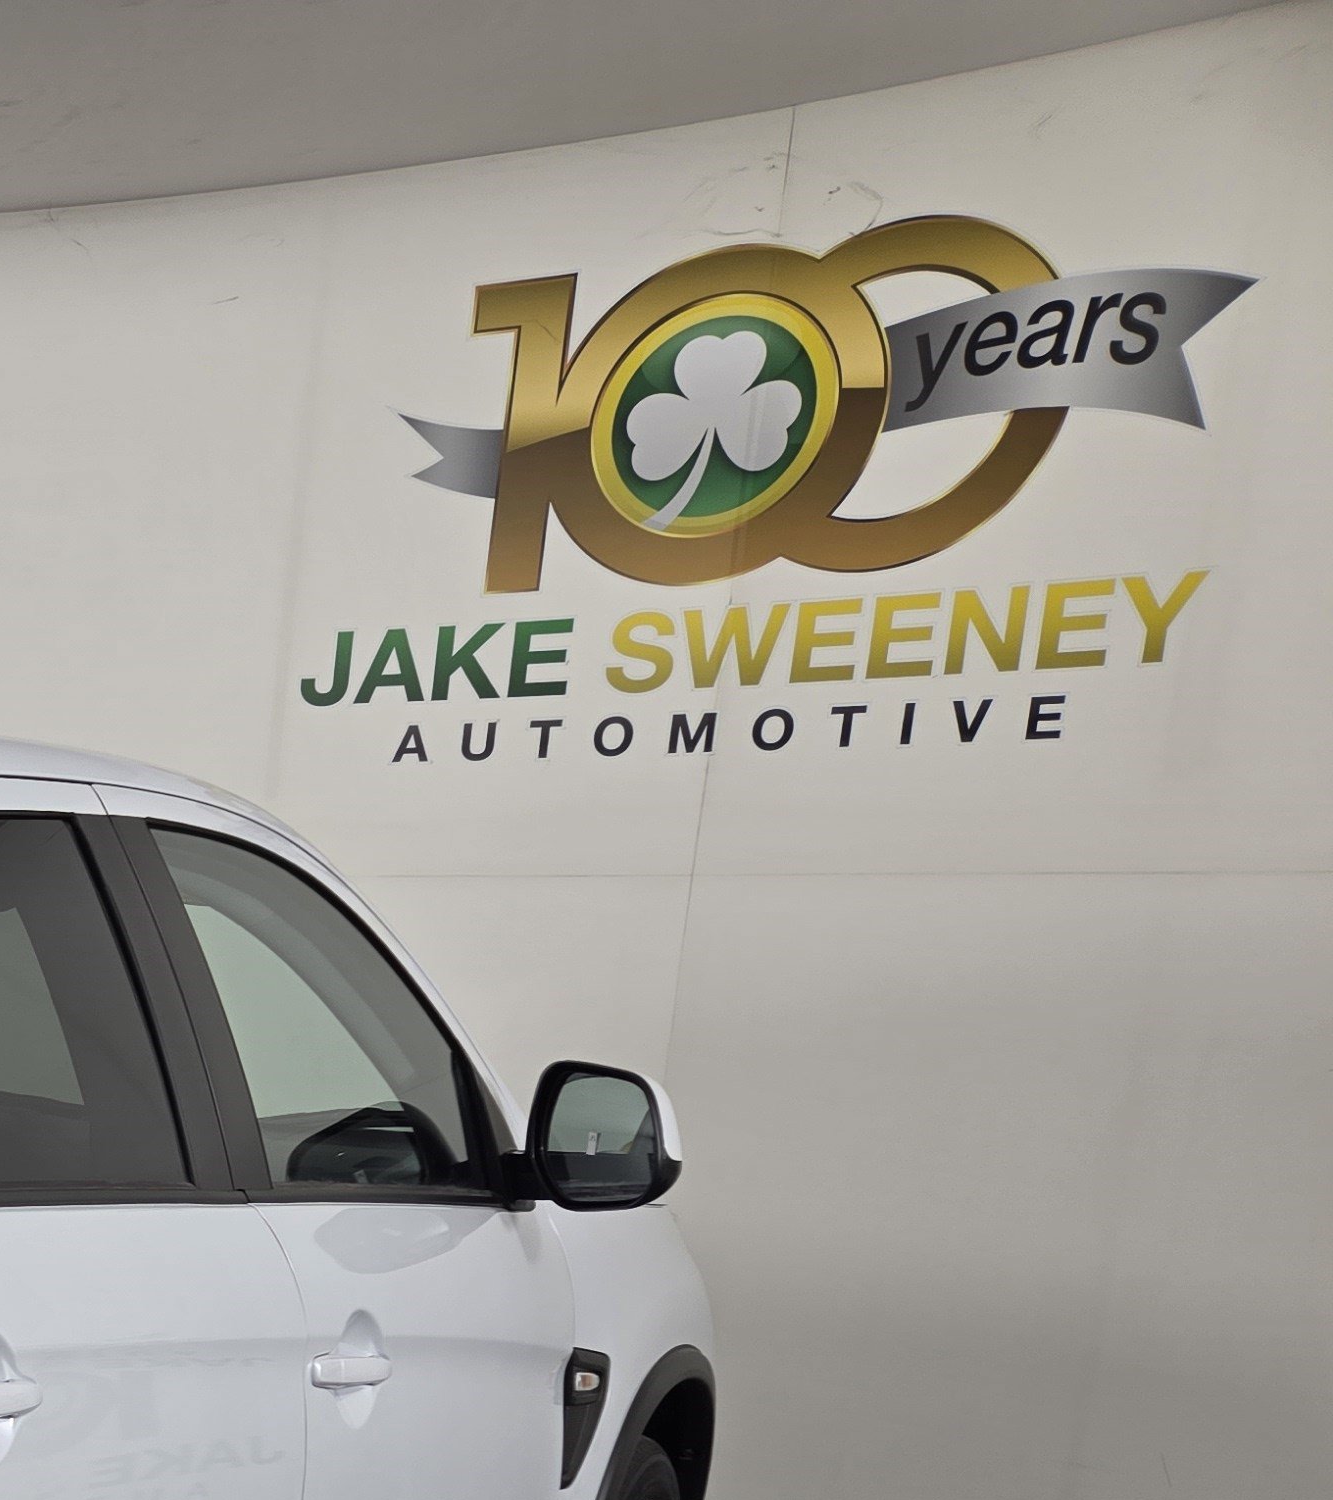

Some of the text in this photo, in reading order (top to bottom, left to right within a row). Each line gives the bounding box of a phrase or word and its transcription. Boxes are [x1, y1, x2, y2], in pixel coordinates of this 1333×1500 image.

[904, 290, 1167, 412] years
[300, 569, 1210, 707] JAKE SWEENEY
[392, 694, 1068, 763] AUTOMOTIVE
